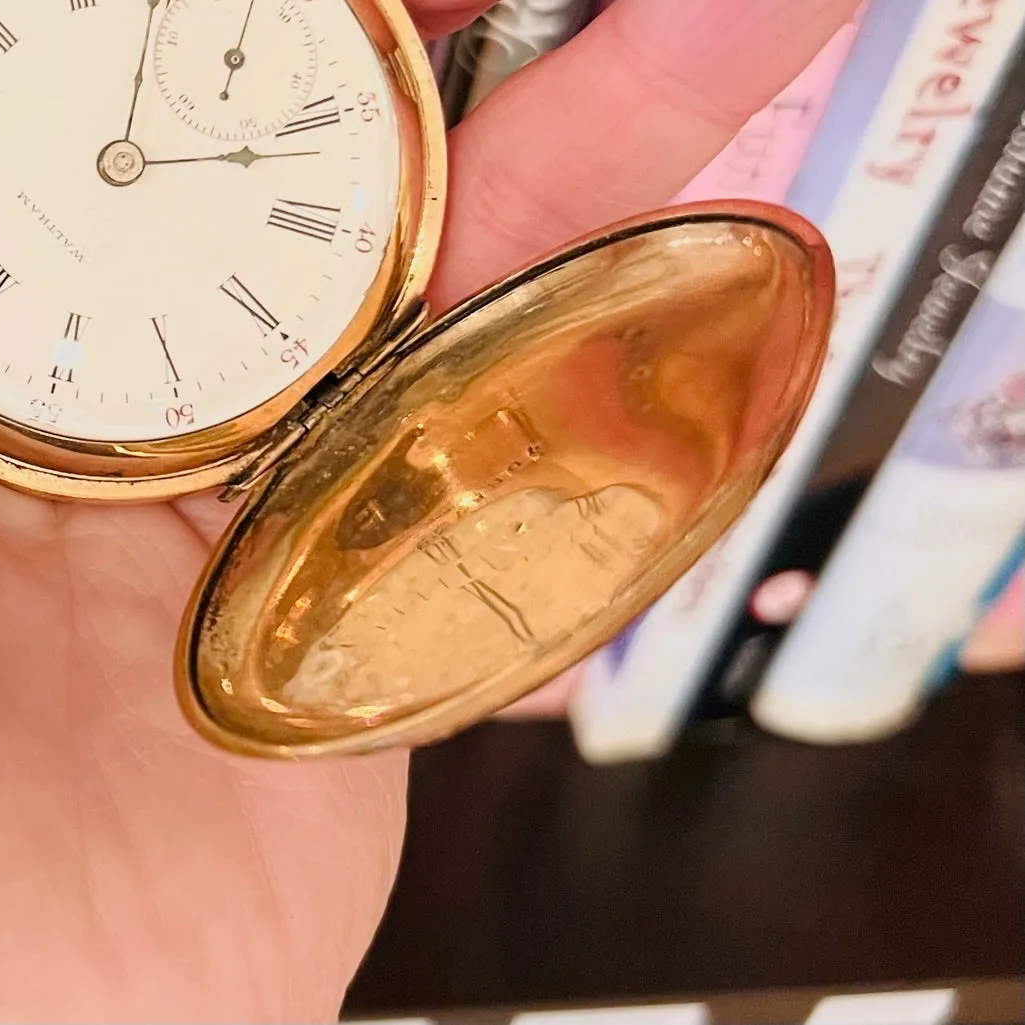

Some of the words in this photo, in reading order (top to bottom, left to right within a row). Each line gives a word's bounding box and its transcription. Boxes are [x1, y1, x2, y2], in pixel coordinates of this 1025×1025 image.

[166, 30, 179, 47] 10
[356, 90, 381, 123] 35
[16, 190, 84, 263] WALTHAM
[353, 221, 376, 254] 40
[871, 242, 996, 387] Jewelry
[279, 336, 310, 370] 45
[28, 397, 63, 426] 55
[164, 403, 196, 429] 50
